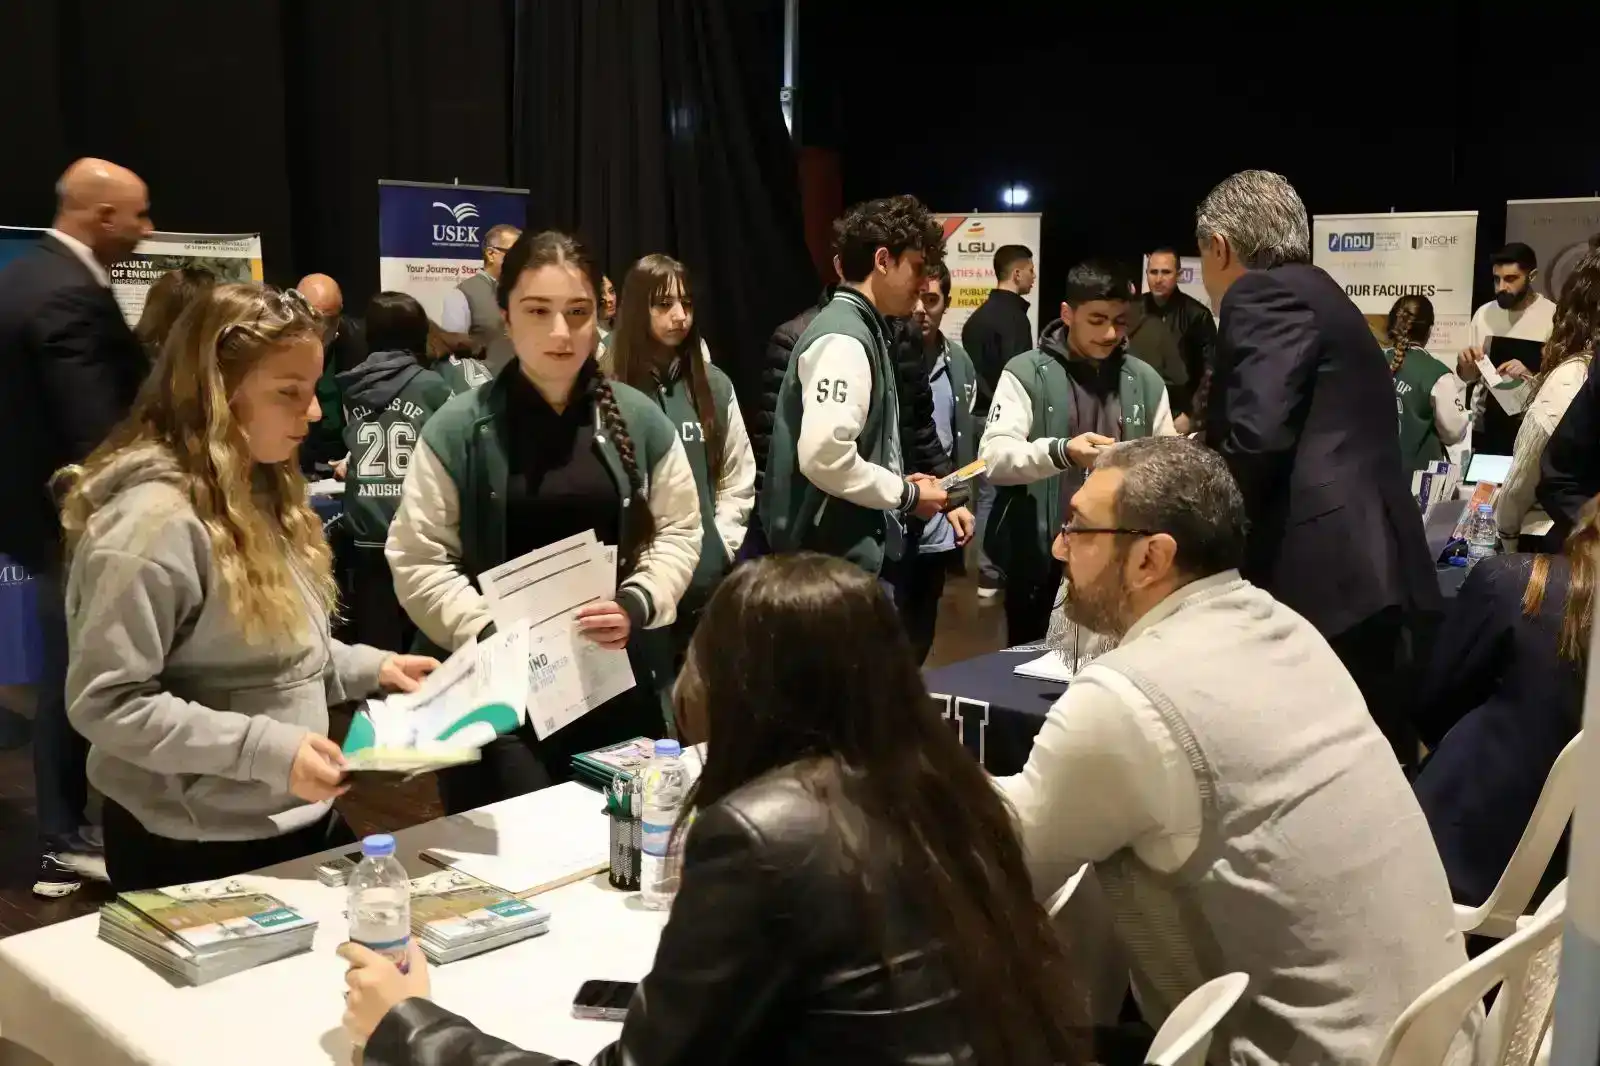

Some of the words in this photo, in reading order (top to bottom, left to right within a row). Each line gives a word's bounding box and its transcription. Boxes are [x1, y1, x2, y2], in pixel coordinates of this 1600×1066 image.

[433, 224, 480, 243] USEK
[1424, 235, 1459, 245] NECHE
[958, 242, 995, 253] LGU
[111, 269, 125, 278] OF
[406, 264, 424, 273] Your
[426, 264, 459, 276] Journey
[1345, 284, 1370, 297] OUR
[1373, 284, 1436, 297] FACULTIES
[816, 378, 849, 404] SG
[1396, 380, 1413, 395] OF
[402, 400, 425, 420] OF
[356, 421, 417, 479] 26
